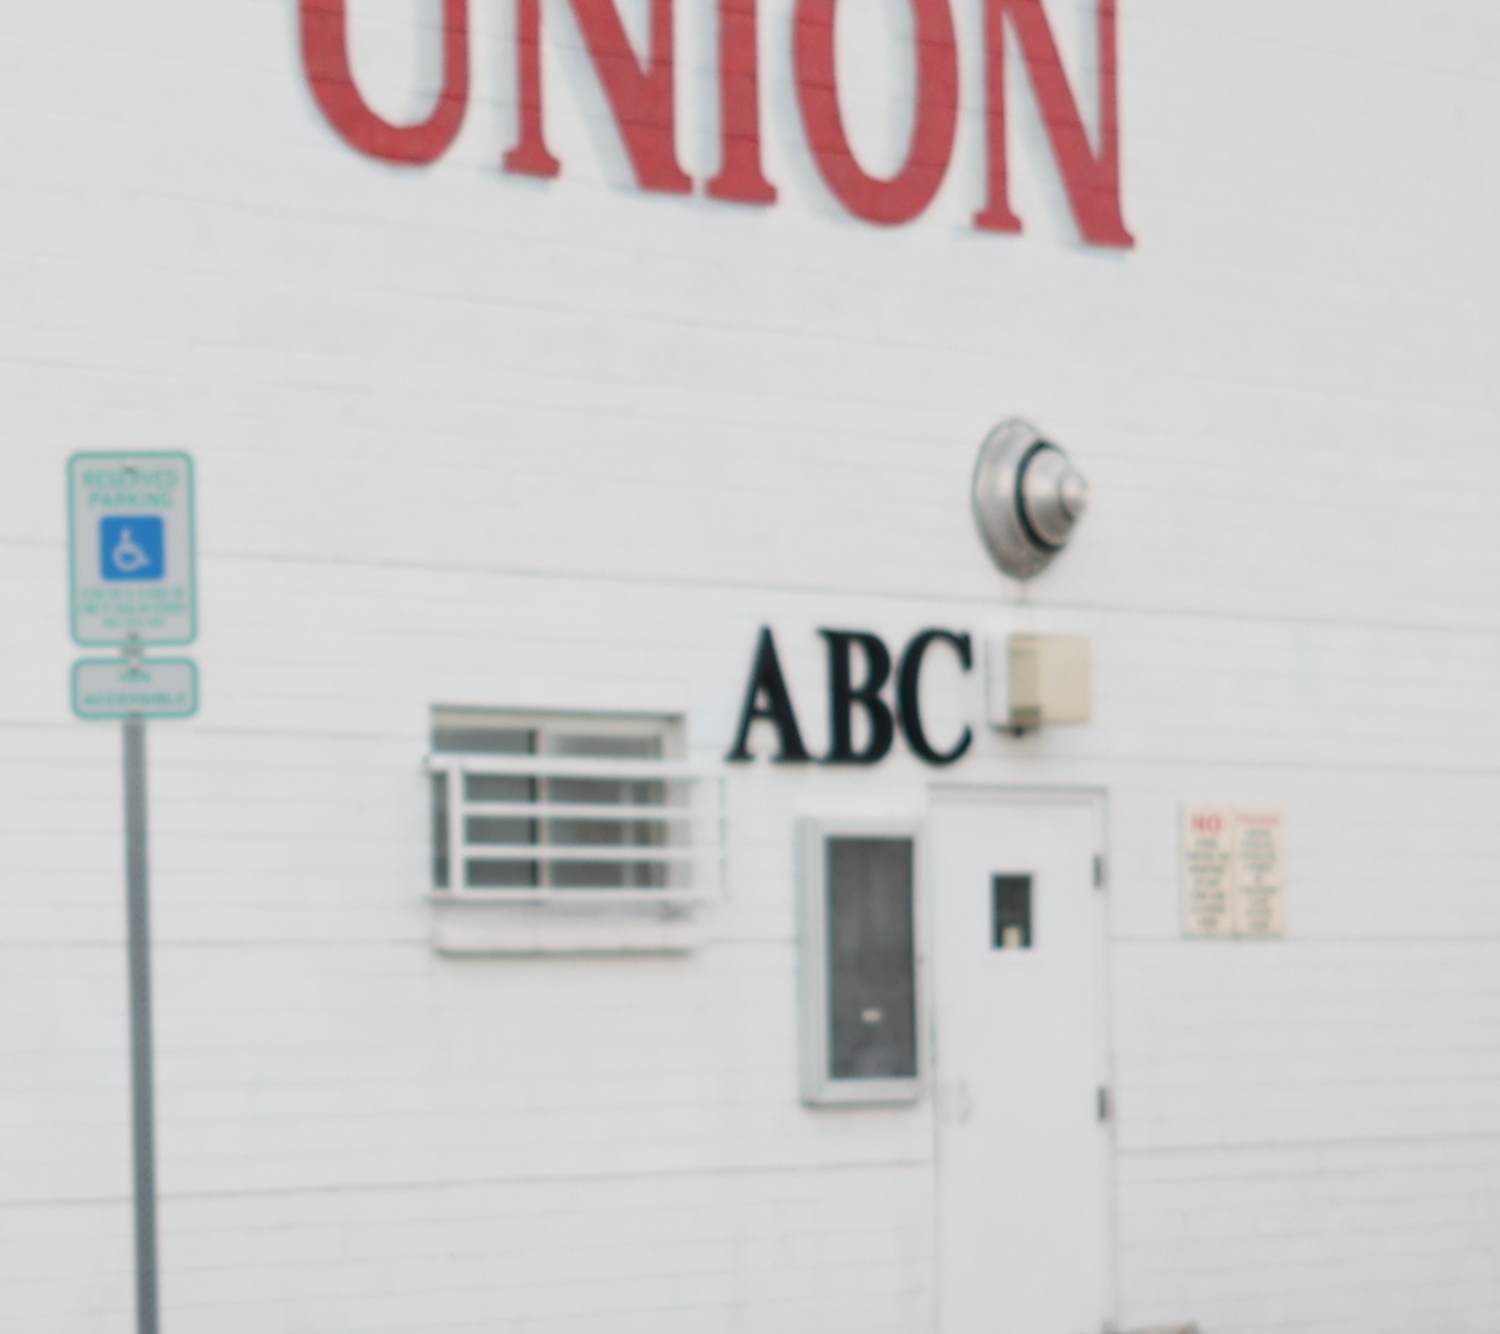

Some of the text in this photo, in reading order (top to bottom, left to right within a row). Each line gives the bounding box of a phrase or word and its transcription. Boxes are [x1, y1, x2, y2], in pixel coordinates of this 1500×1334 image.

[83, 470, 178, 488] RESERVED
[89, 492, 174, 509] PARKING
[725, 626, 974, 768] ABC
